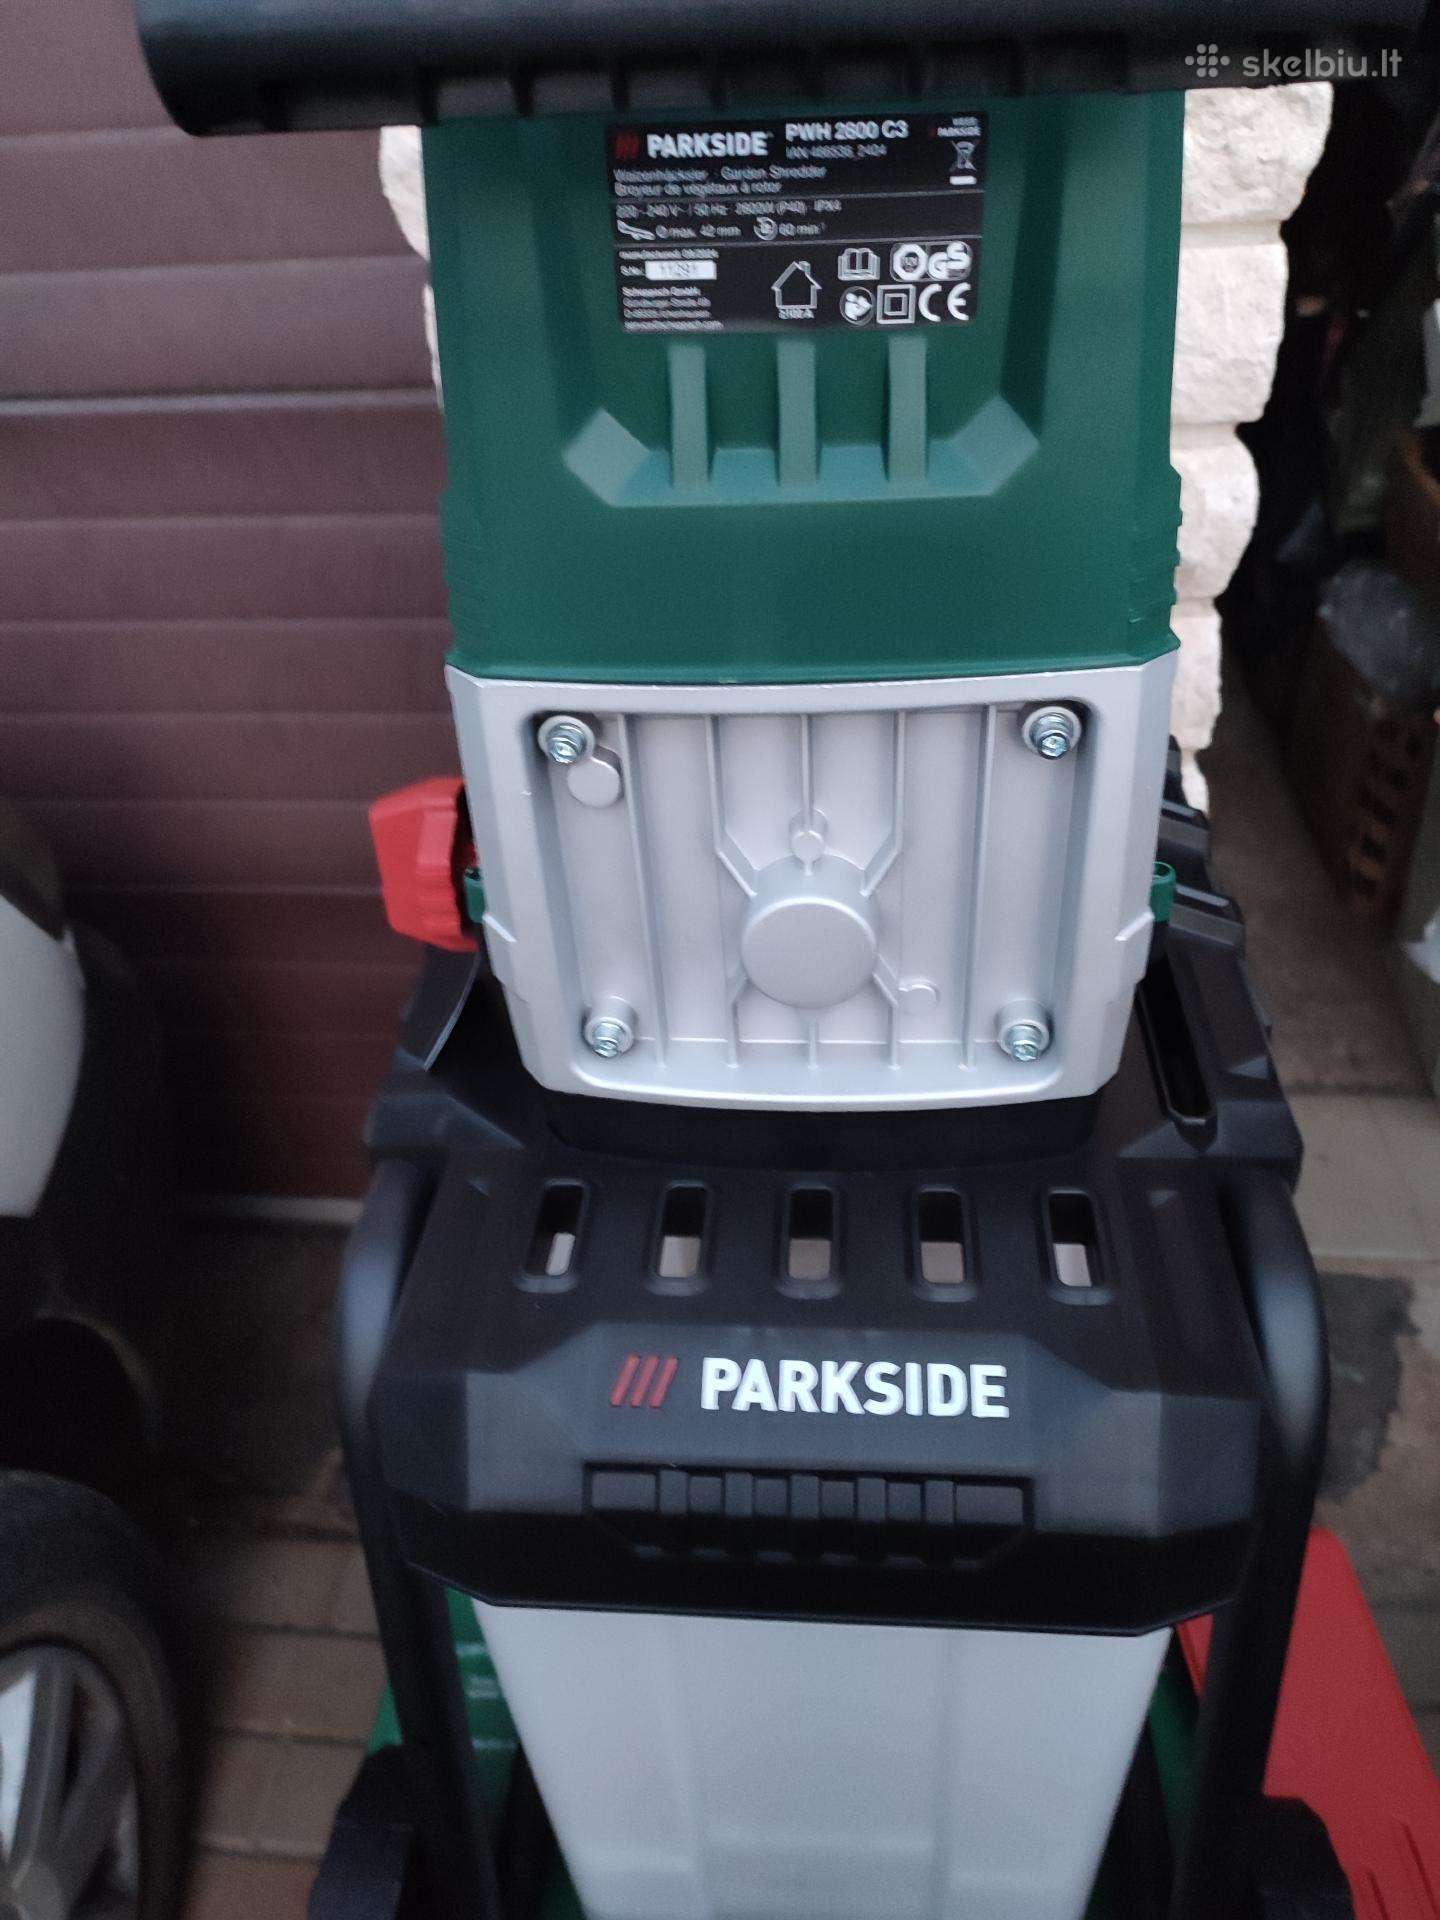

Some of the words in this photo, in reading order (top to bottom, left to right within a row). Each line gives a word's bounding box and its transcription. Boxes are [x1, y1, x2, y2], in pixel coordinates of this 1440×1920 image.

[647, 131, 770, 159] PARKSIDE
[785, 121, 832, 142] PWH
[701, 1357, 1010, 1418] PARKSIDE
